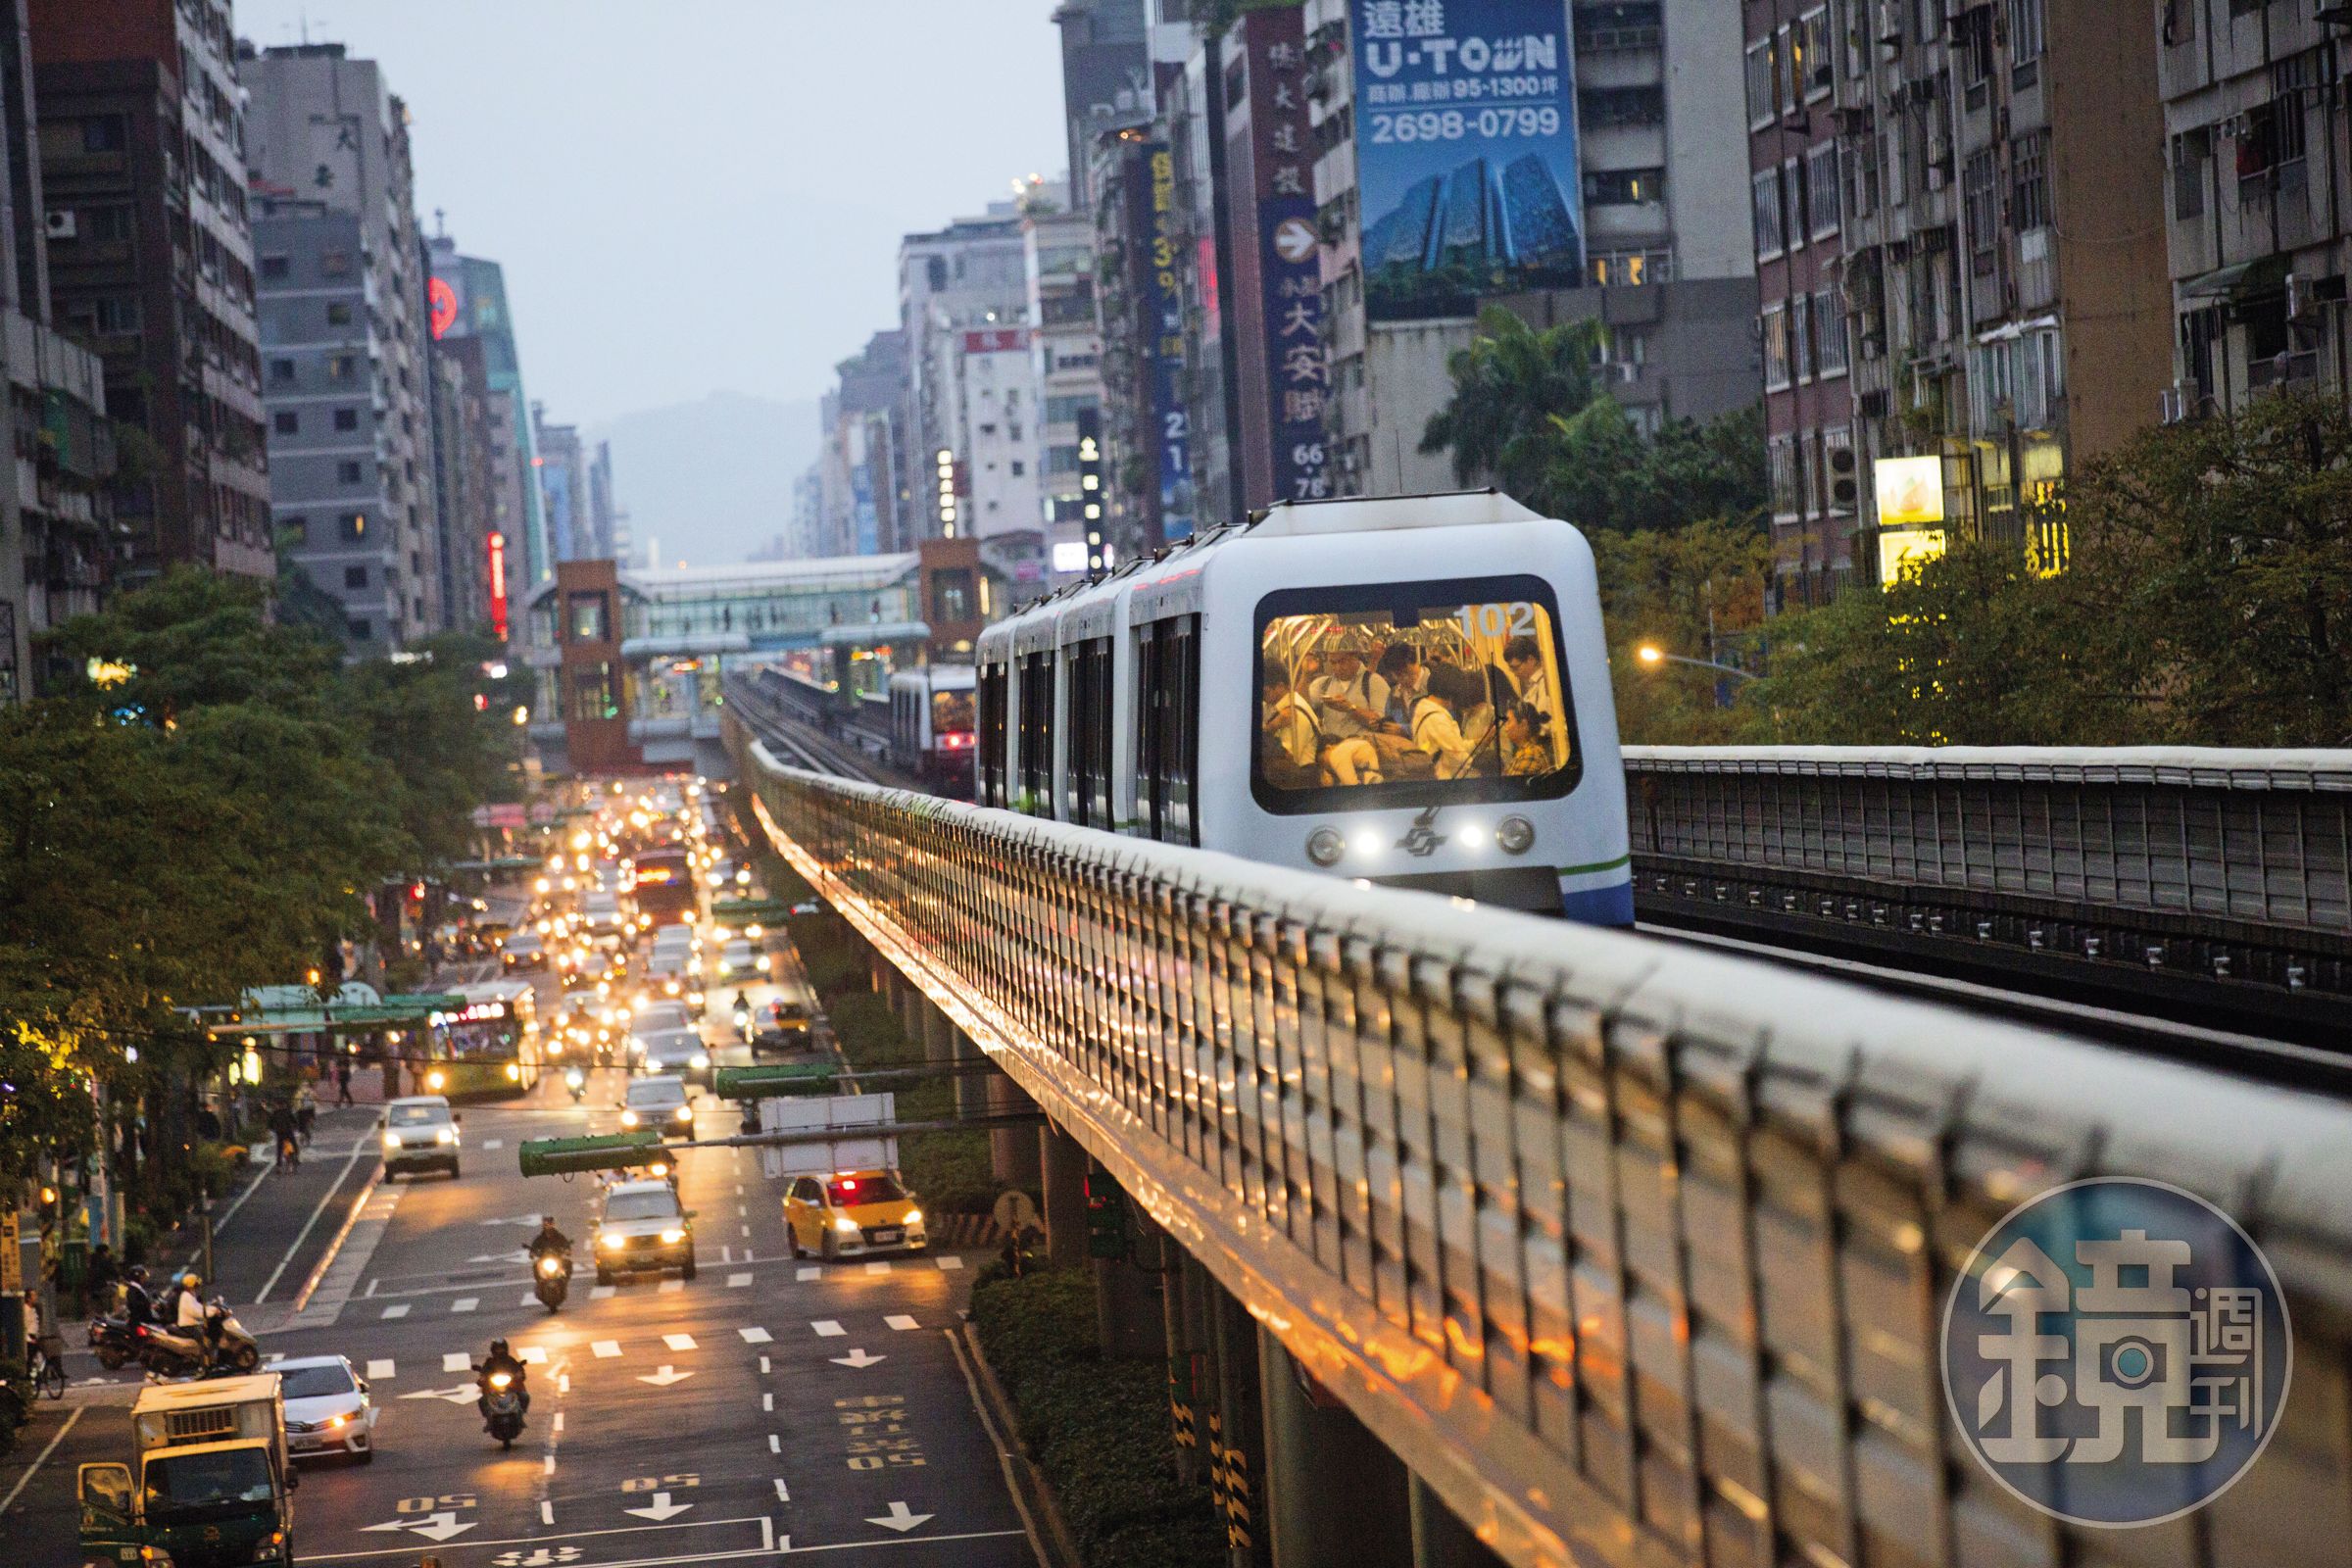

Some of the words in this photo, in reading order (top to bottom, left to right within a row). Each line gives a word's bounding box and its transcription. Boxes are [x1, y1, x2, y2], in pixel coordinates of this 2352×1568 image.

[1372, 107, 1559, 143] 2698-0799
[1453, 601, 1537, 641] 102
[397, 1494, 477, 1513] 50
